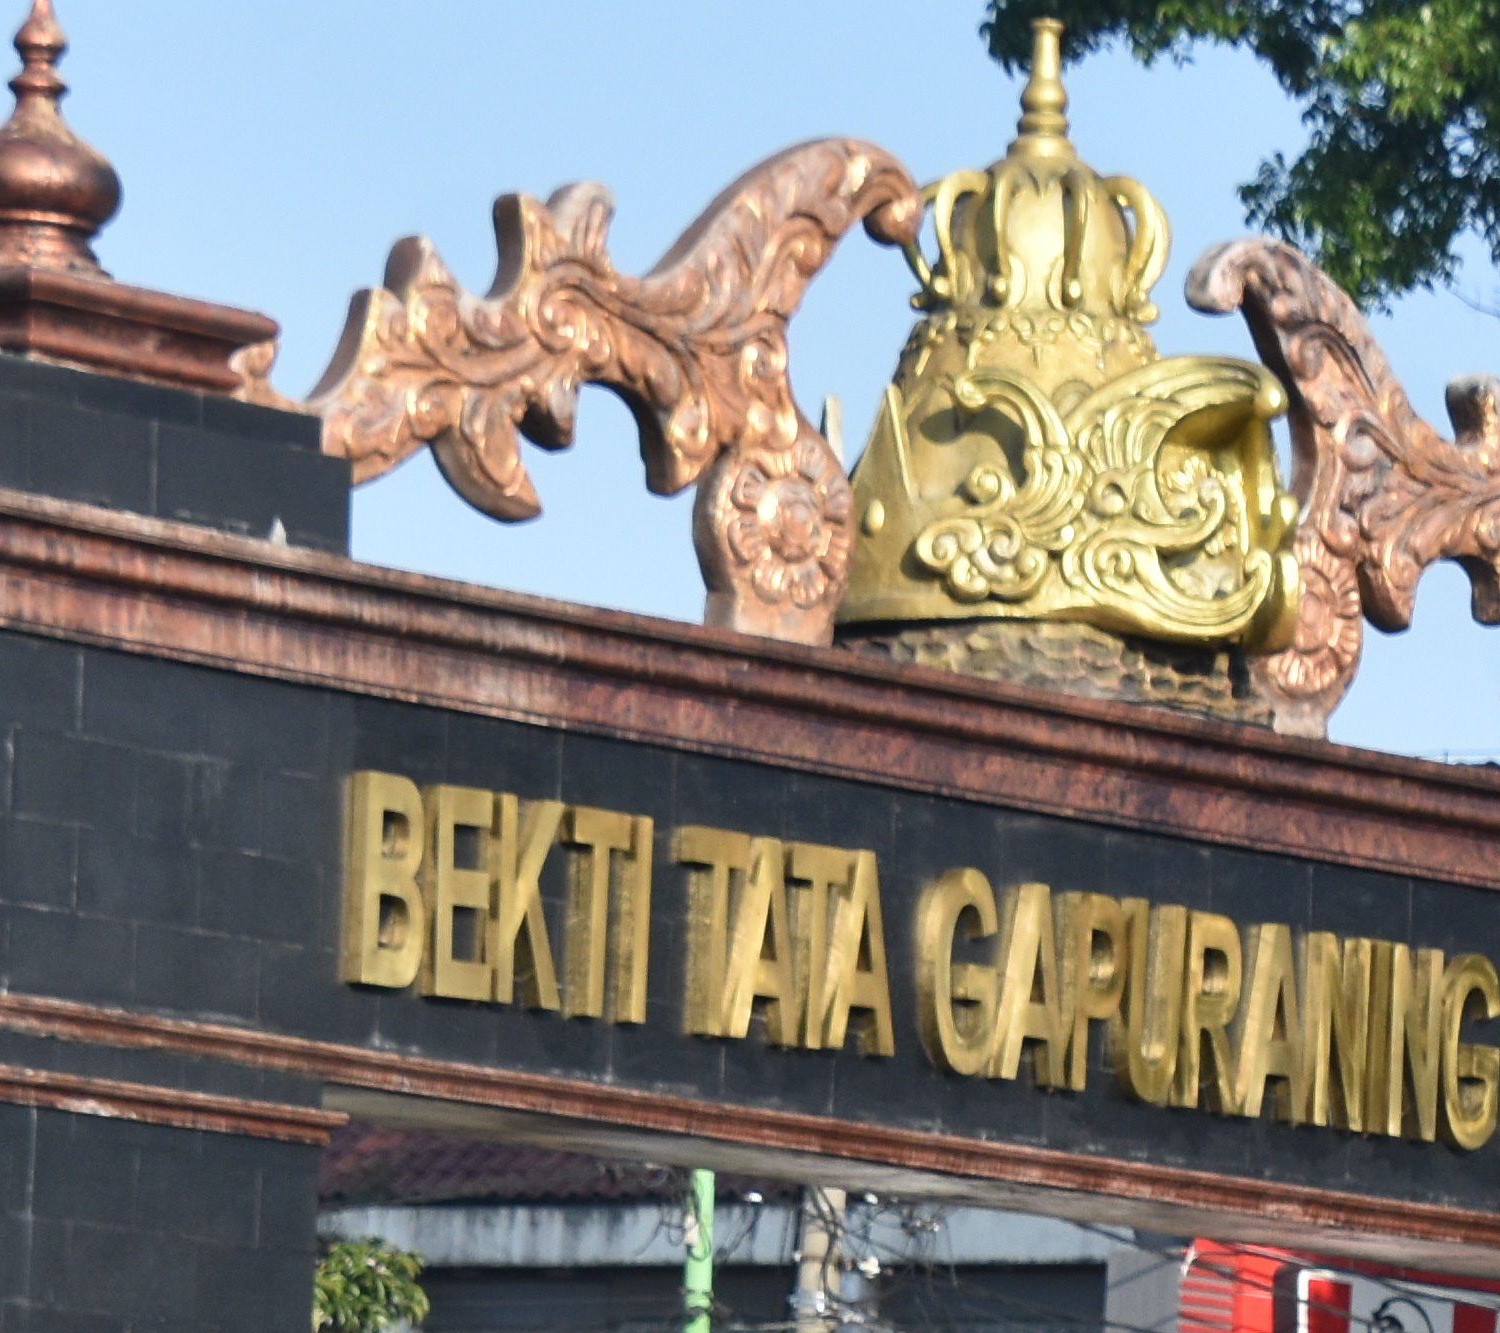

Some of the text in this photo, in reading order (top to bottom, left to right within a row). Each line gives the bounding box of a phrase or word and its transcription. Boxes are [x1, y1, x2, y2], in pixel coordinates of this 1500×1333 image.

[342, 769, 654, 1026] BEKTI
[672, 824, 896, 1058] TATA
[913, 865, 1500, 1154] GAPURANING
